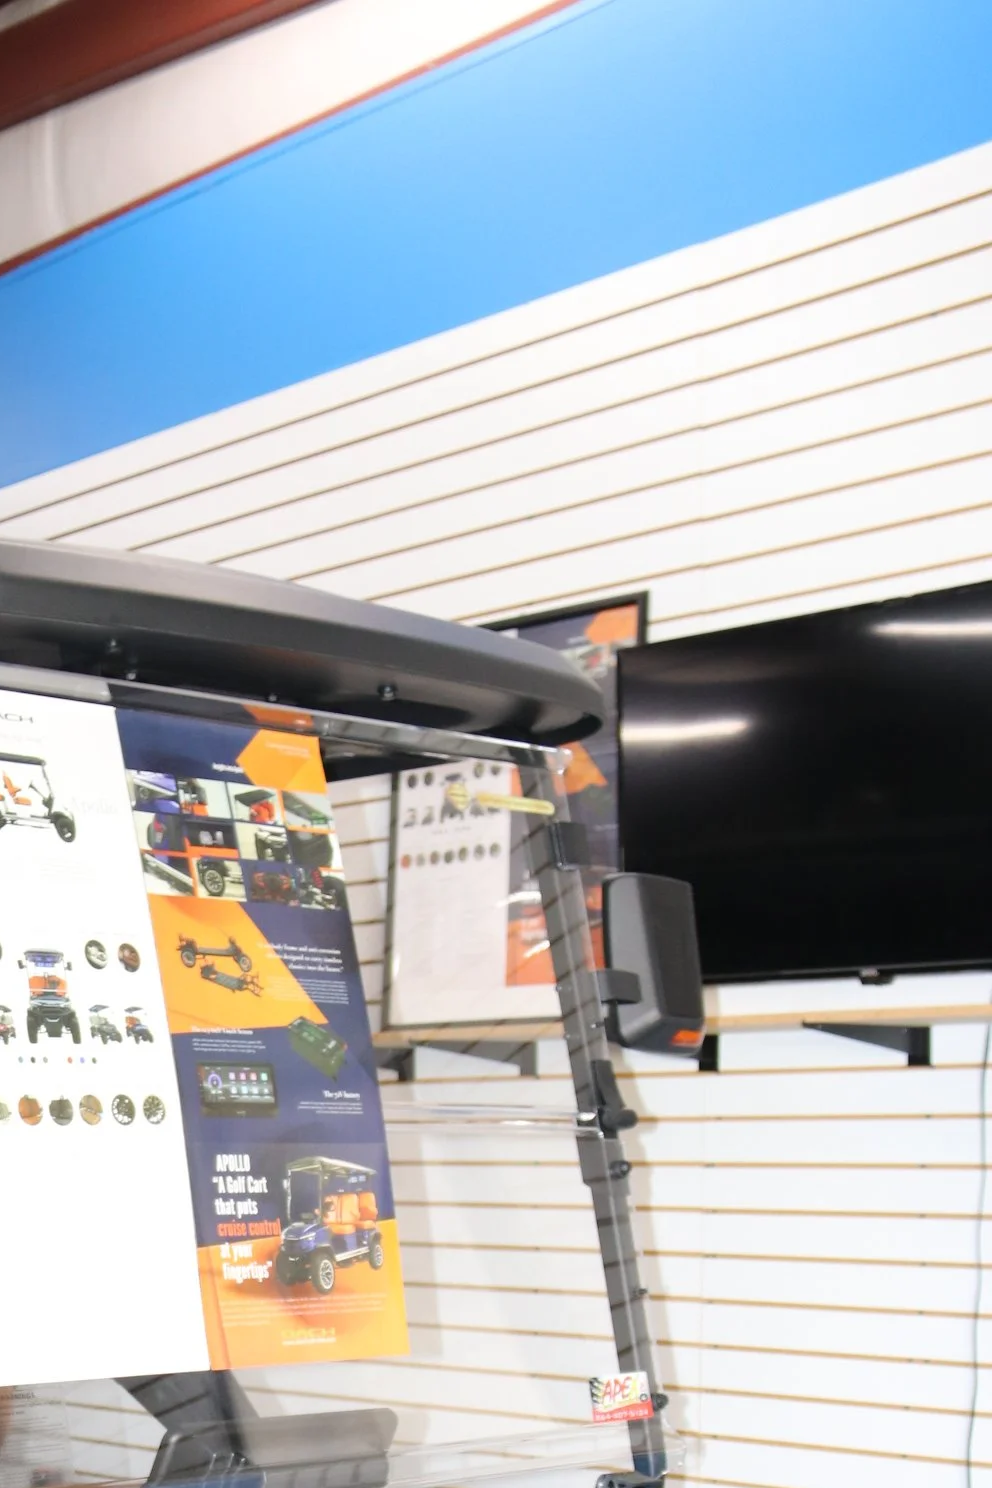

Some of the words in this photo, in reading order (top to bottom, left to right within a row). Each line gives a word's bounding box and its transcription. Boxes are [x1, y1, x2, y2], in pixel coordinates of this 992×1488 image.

[216, 1153, 251, 1173] APOLLO
[227, 1175, 246, 1194] Golf
[247, 1176, 268, 1194] Cart
[215, 1198, 236, 1216] that
[236, 1199, 258, 1219] puts
[217, 1220, 248, 1236] cruise
[249, 1217, 282, 1237] control
[220, 1242, 231, 1259] at
[232, 1243, 253, 1262] your
